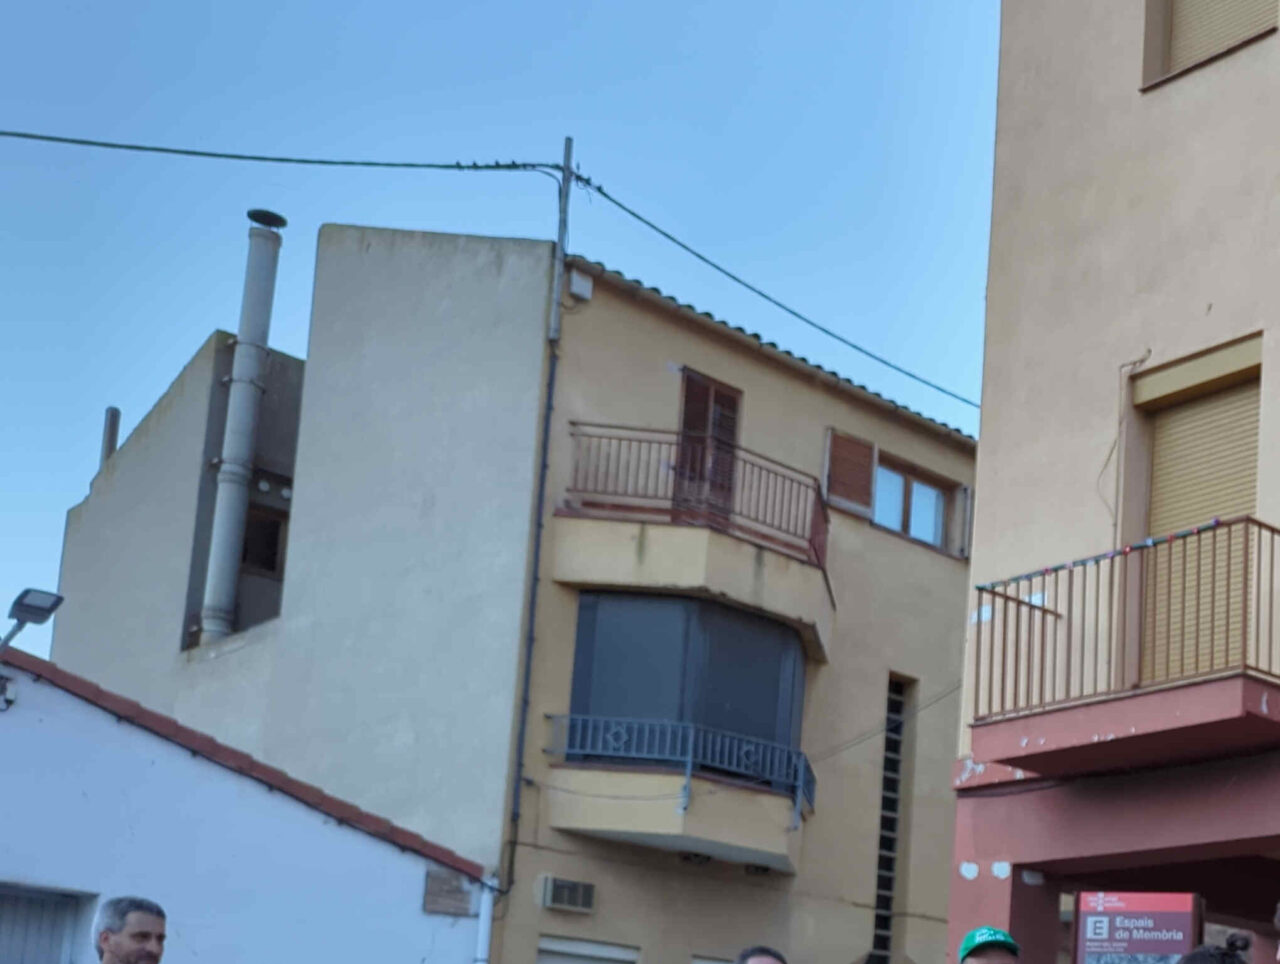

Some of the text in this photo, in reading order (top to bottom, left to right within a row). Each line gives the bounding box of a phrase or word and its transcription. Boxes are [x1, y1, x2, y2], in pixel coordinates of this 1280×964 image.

[1115, 916, 1154, 929] Espais
[1115, 929, 1184, 941] de Memòria
